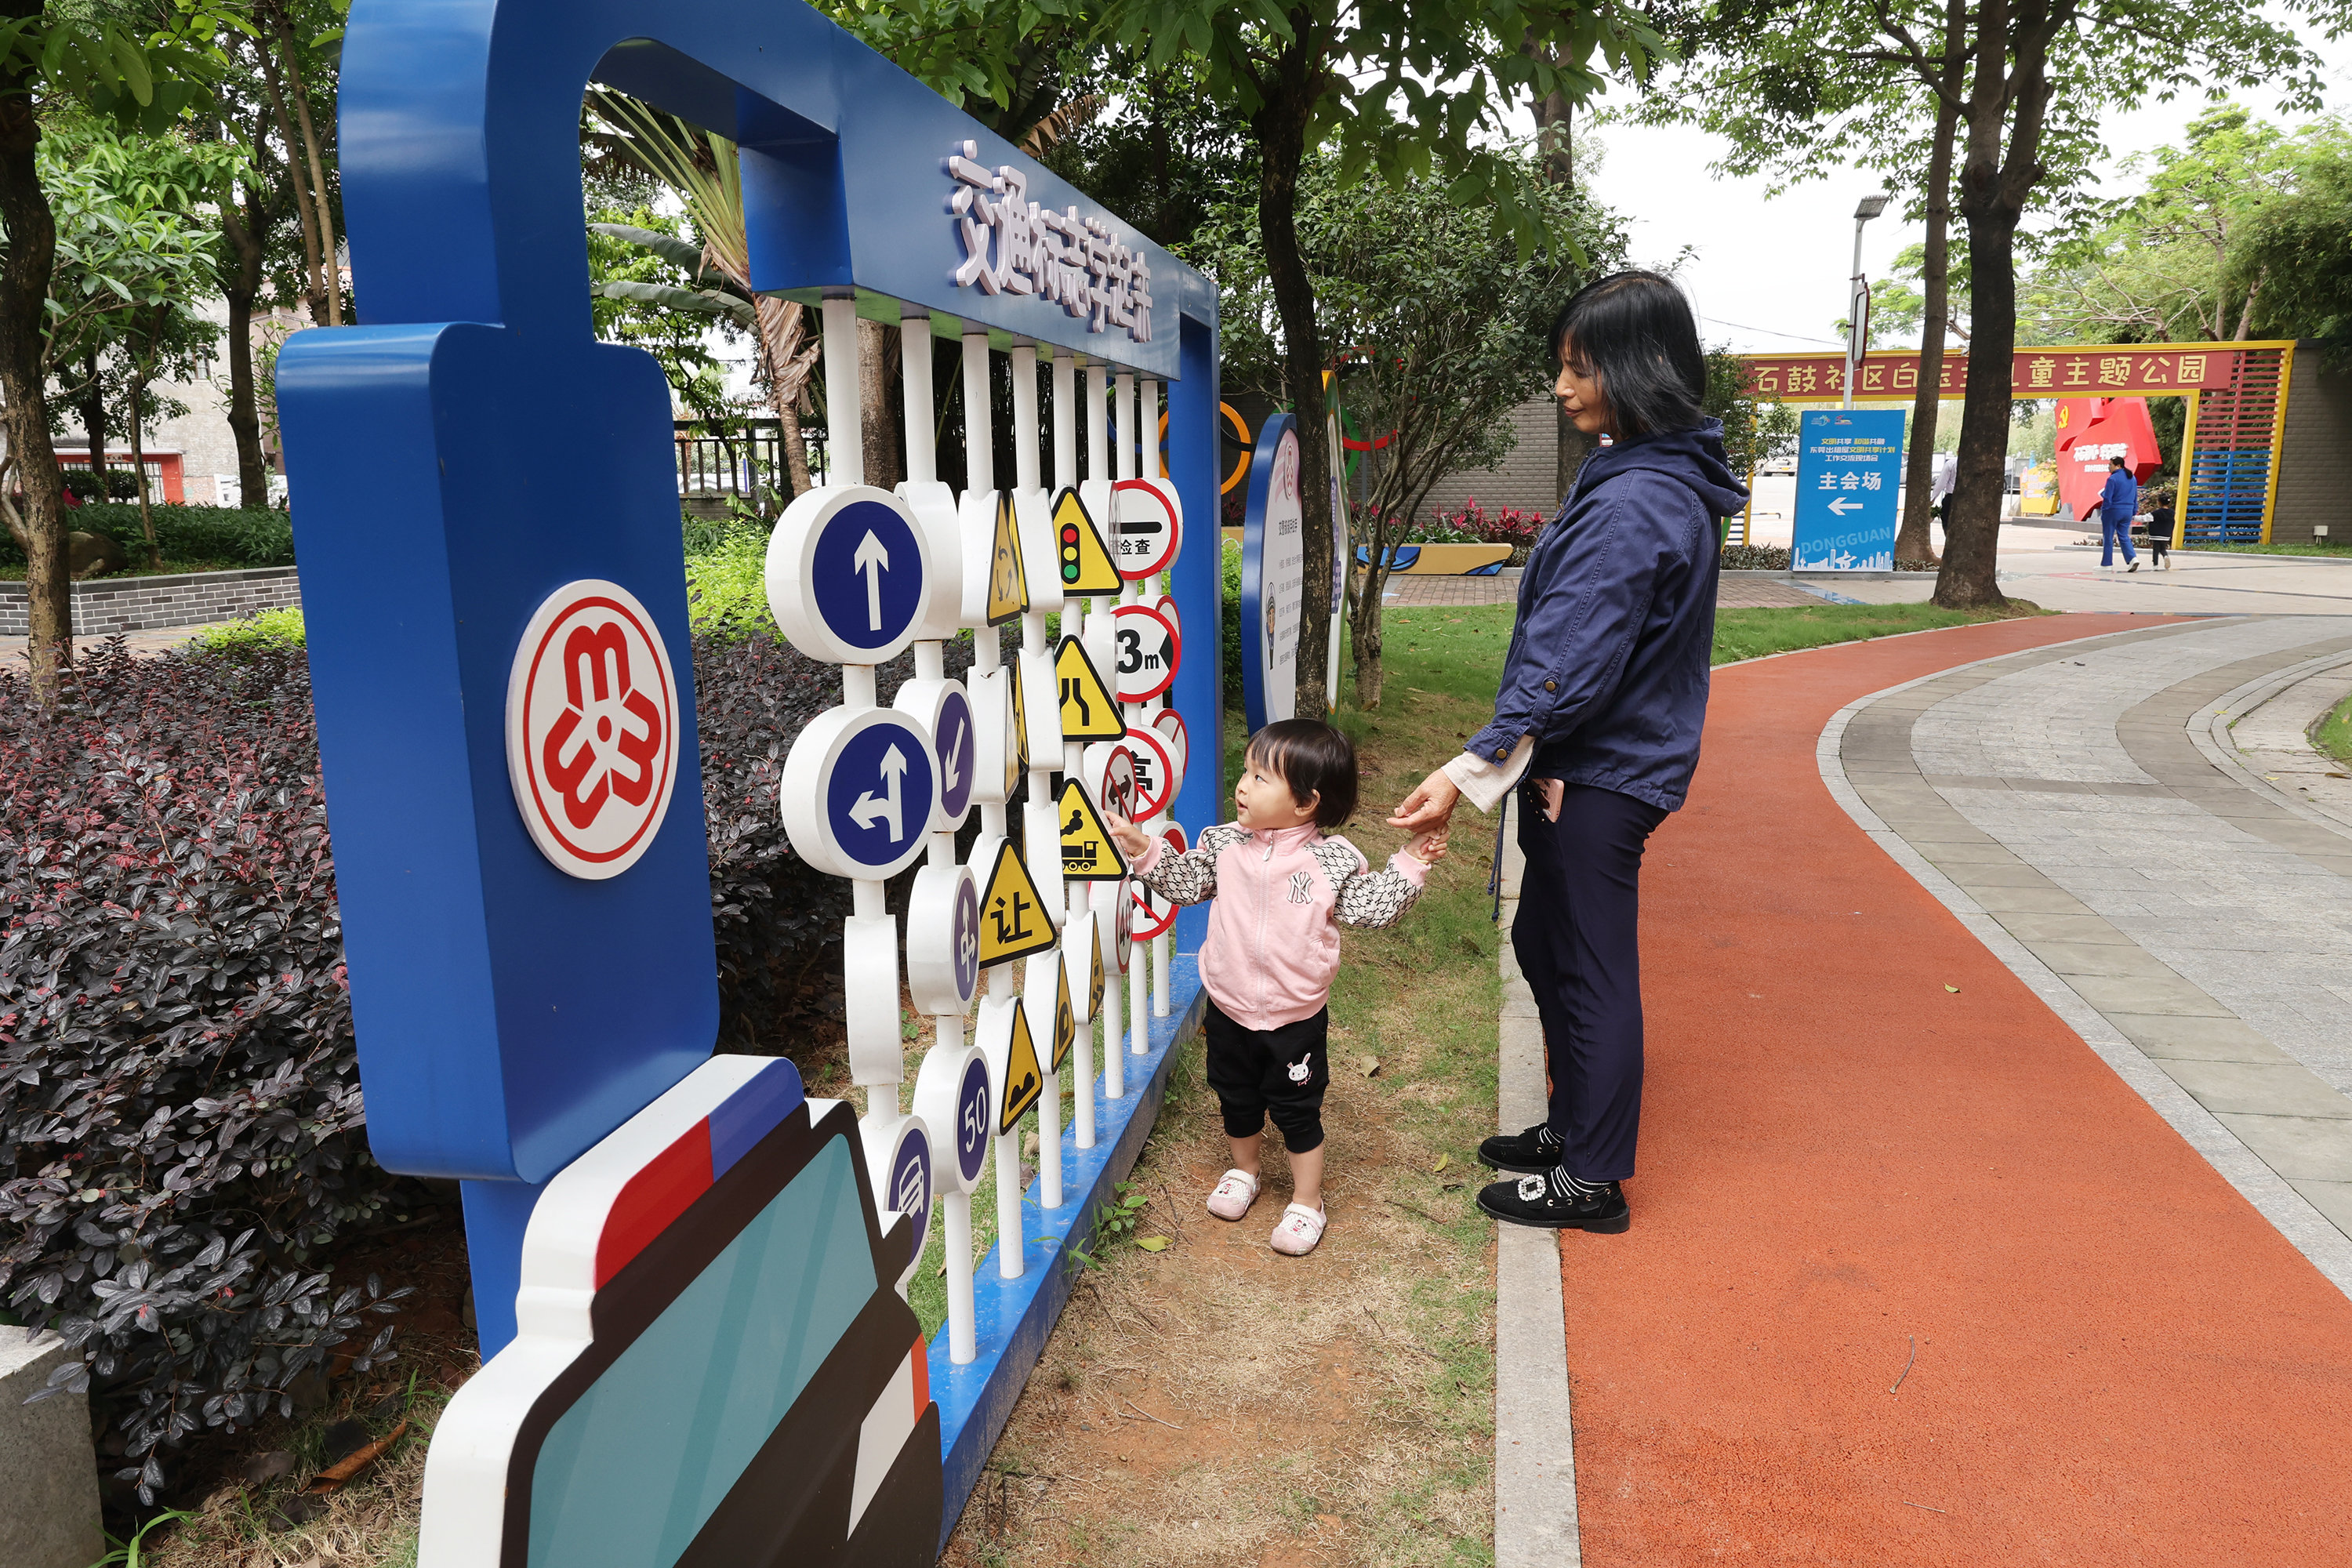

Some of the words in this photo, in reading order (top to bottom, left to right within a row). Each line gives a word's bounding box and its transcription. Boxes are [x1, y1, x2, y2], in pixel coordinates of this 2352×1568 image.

[949, 140, 1153, 343] 交通标志学起来
[1818, 471, 1882, 491] 主会场
[1801, 527, 1890, 554] DONGGUAN
[1287, 871, 1314, 904] NY
[990, 891, 1033, 946] 让
[964, 1086, 986, 1153] 50
